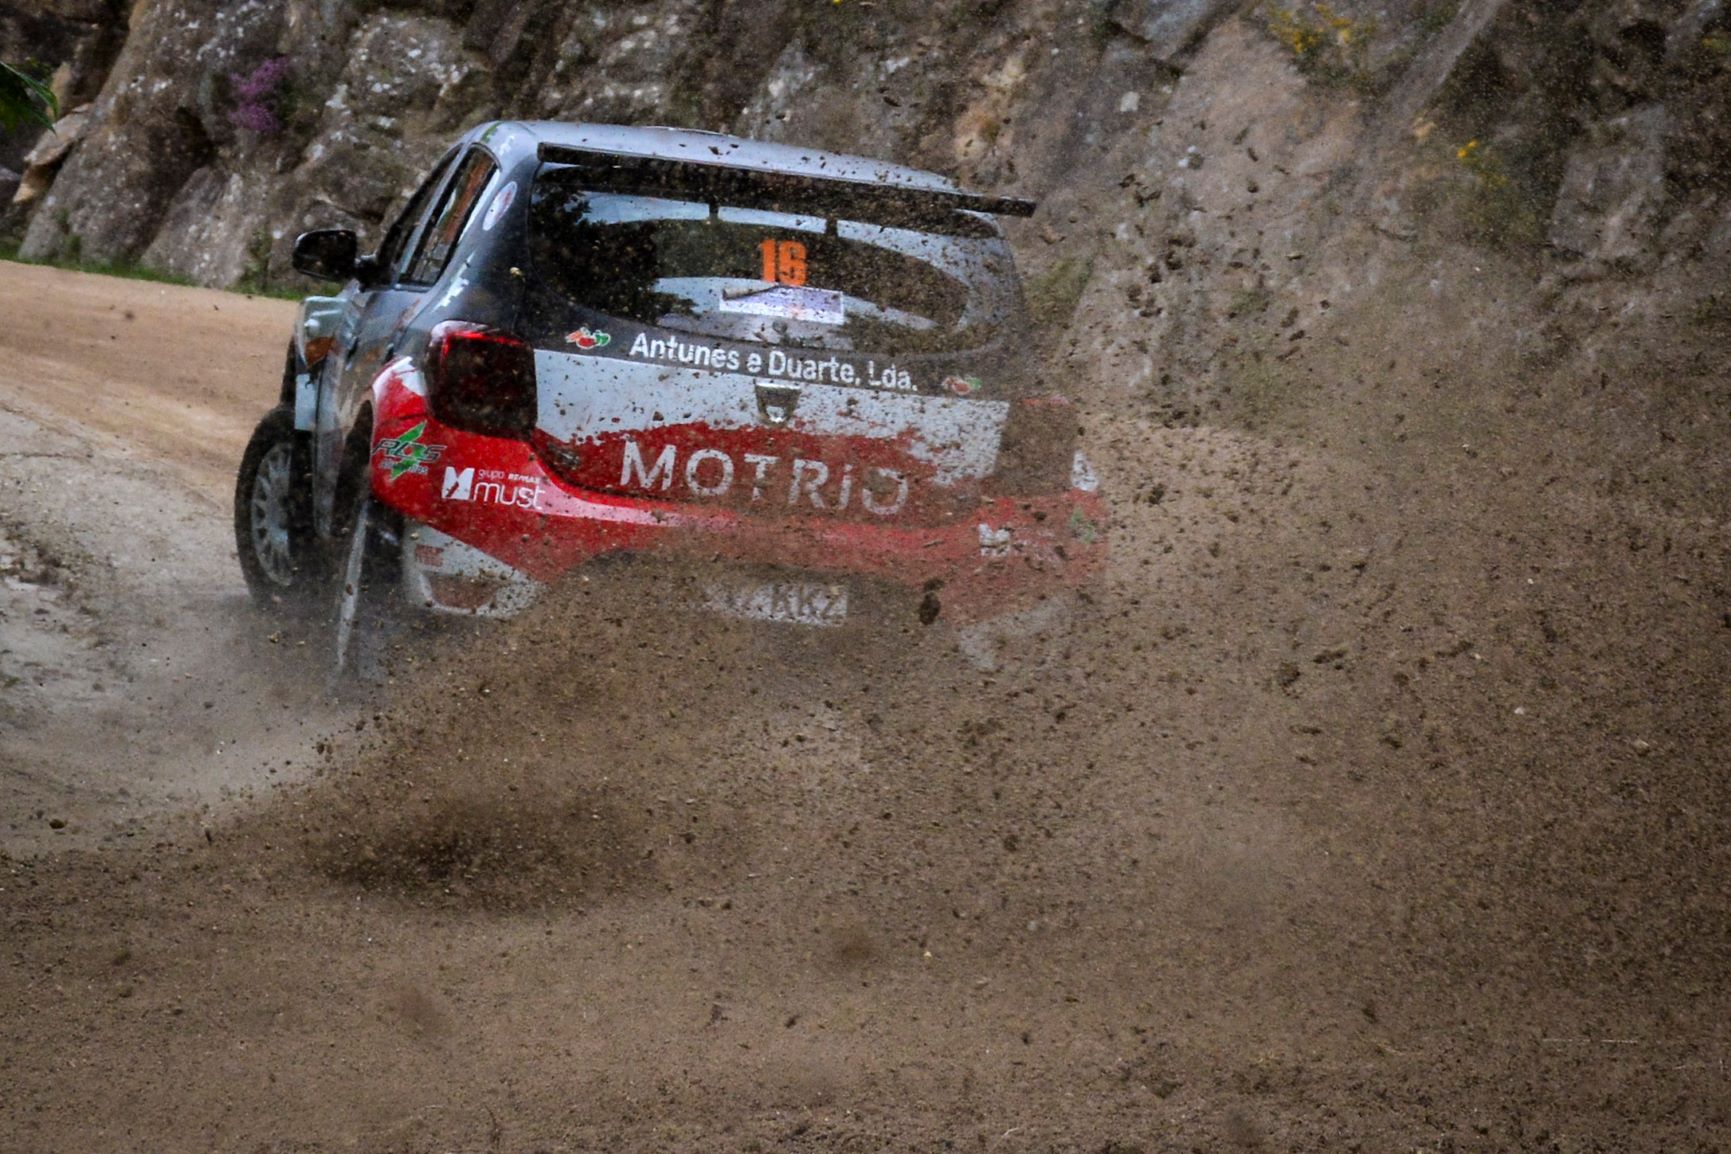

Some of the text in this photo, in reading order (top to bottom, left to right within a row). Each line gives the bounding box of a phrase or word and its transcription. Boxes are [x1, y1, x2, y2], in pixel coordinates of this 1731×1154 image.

[629, 332, 740, 370] Antunes
[746, 352, 762, 373] e
[867, 361, 918, 392] Lda.
[473, 482, 546, 511] must
